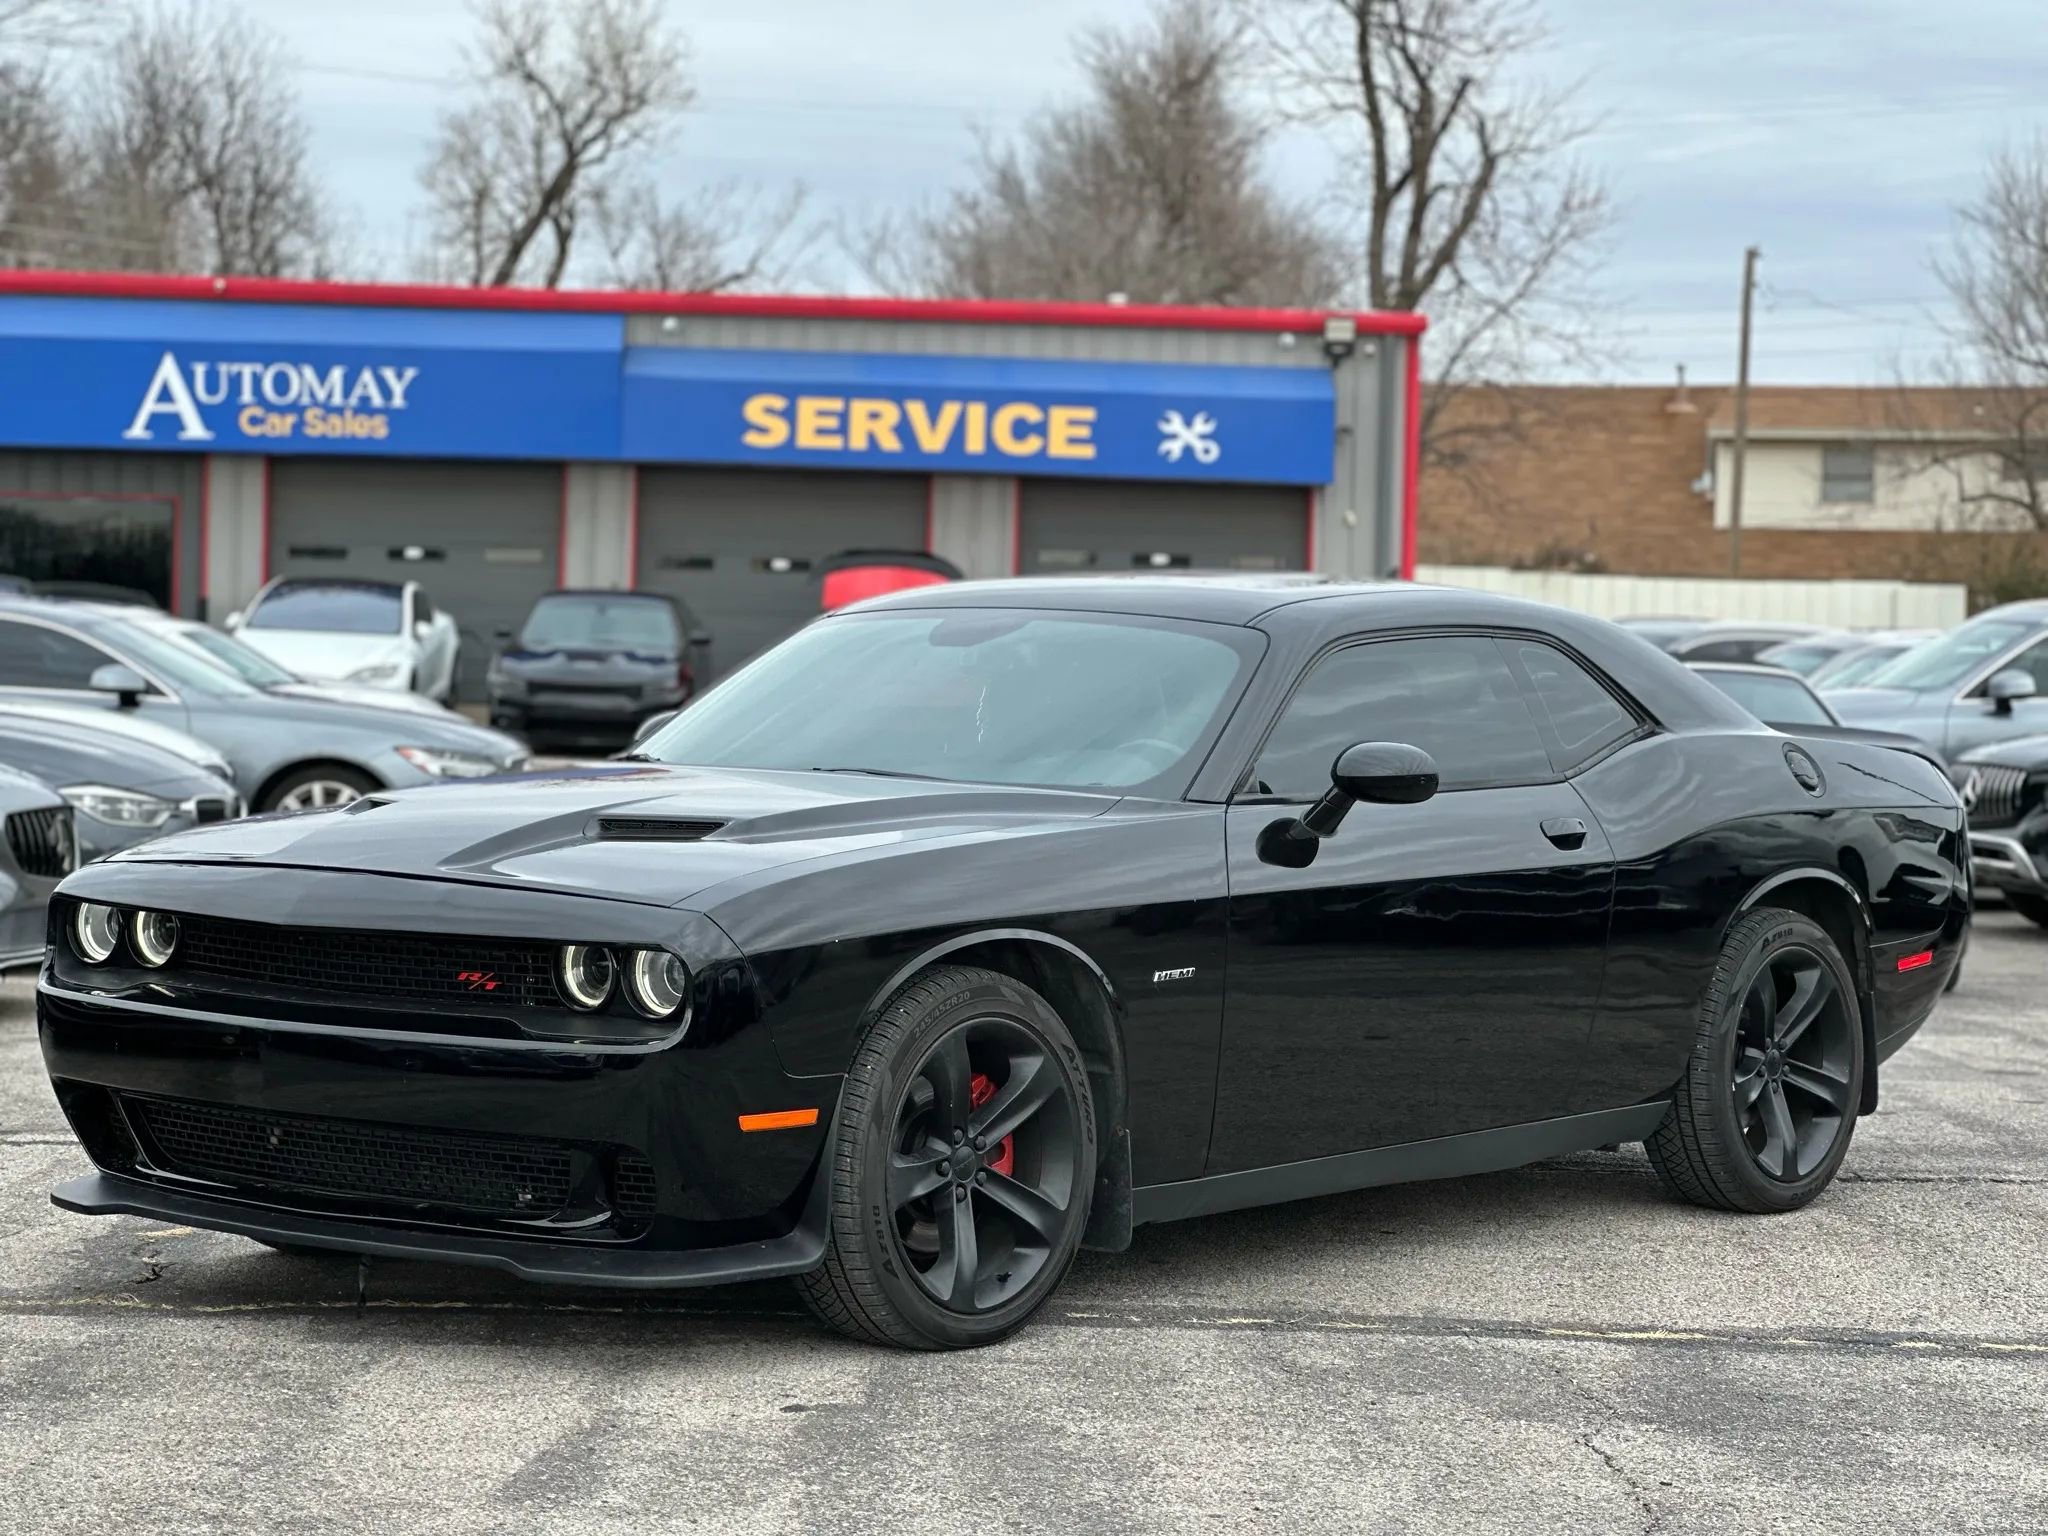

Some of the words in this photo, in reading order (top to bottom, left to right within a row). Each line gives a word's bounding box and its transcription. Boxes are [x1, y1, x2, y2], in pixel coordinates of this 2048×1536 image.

[122, 349, 419, 440] AUTOMAY
[237, 405, 297, 438] Car
[303, 406, 390, 440] Sales
[741, 393, 1097, 460] SERVICE
[457, 971, 504, 990] R/T
[1153, 966, 1196, 982] HEMI
